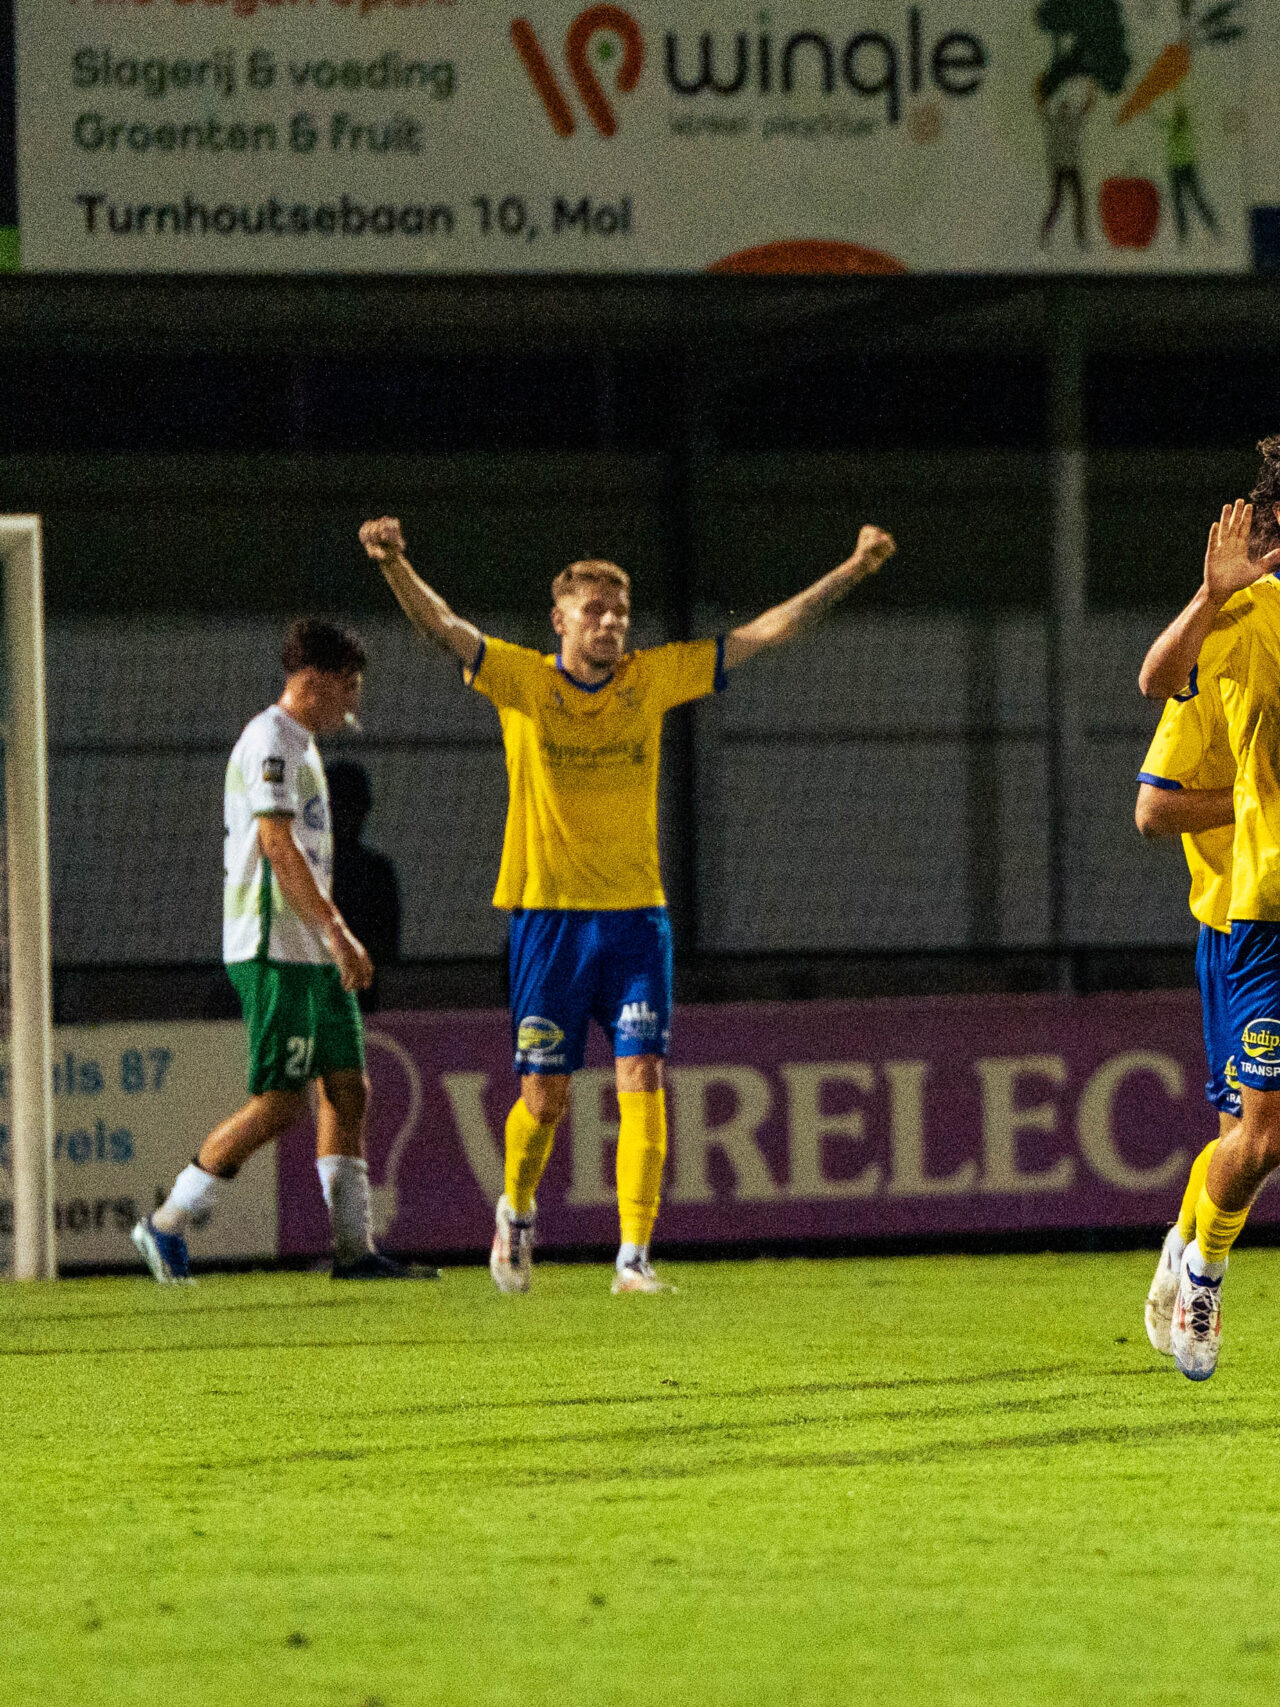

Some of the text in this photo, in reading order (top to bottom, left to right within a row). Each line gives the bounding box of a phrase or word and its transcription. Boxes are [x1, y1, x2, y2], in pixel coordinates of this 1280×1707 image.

[72, 48, 457, 100] Slagerij & voeding
[73, 110, 425, 153] Groenten & fruit
[79, 193, 635, 242] Turnhoutsebaan 10, Mol
[120, 1047, 172, 1094] 87
